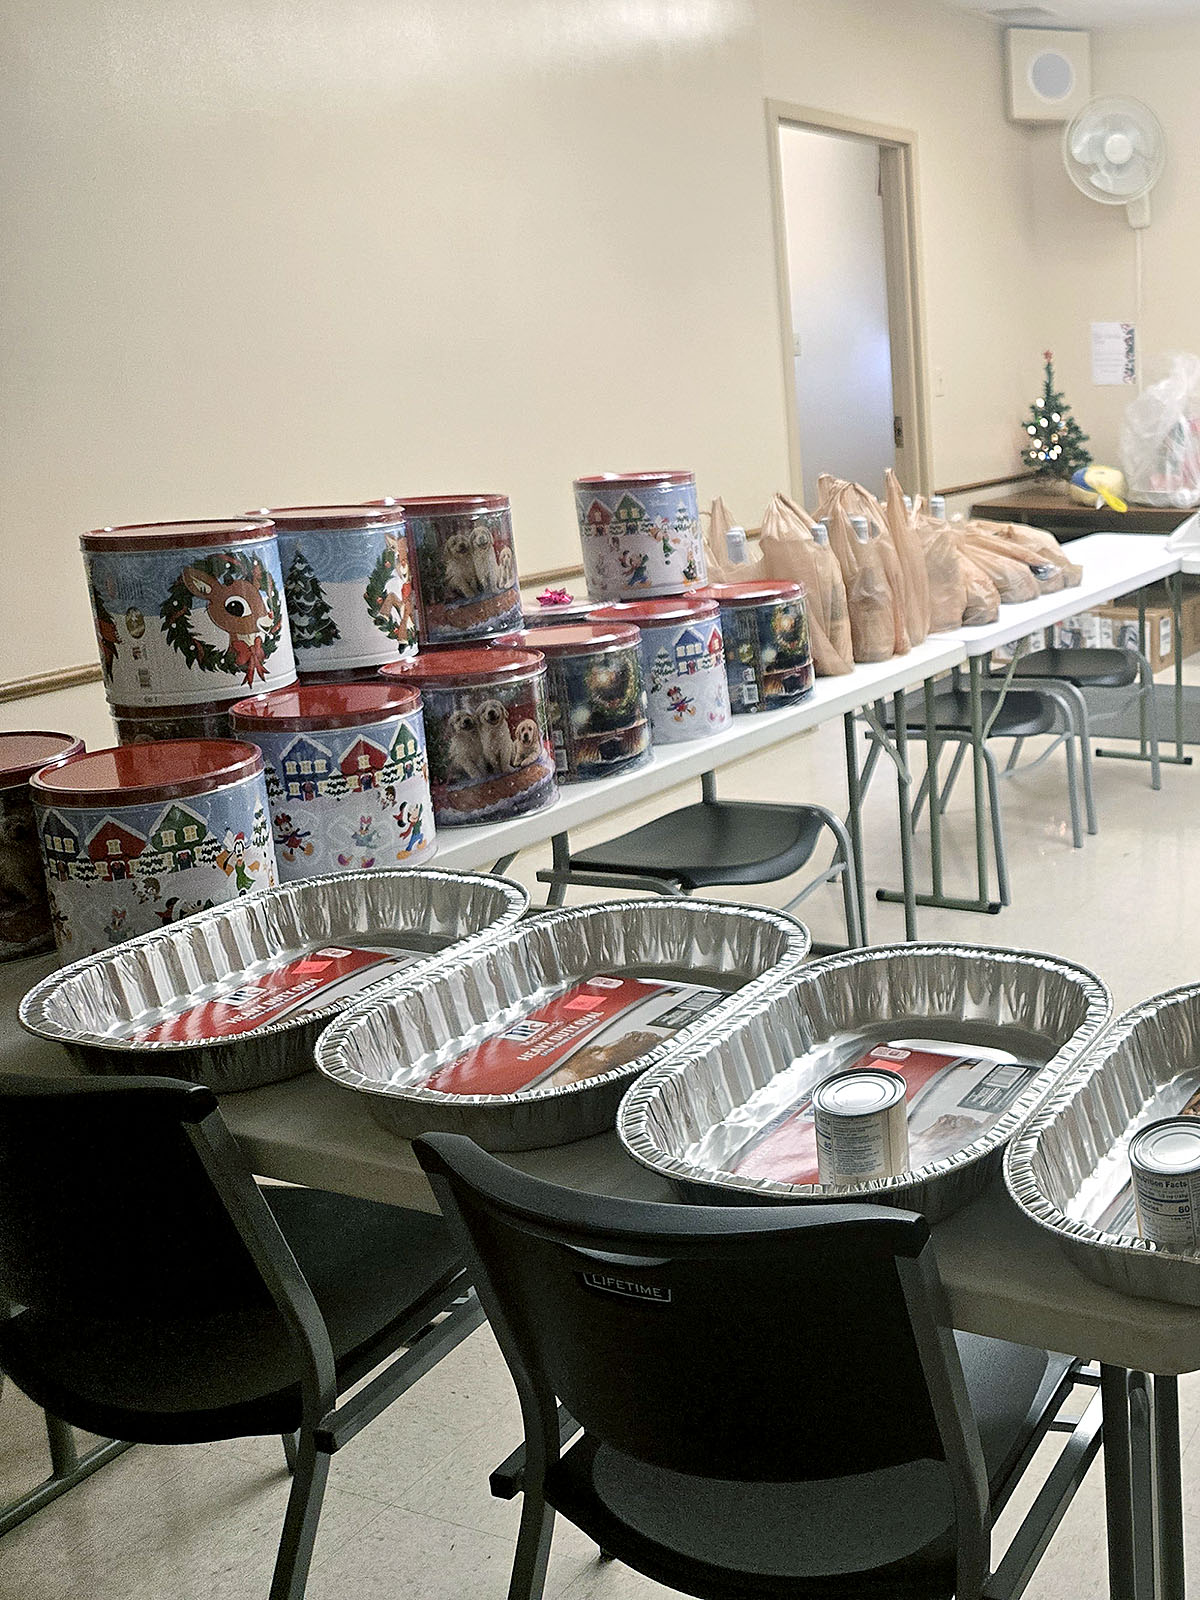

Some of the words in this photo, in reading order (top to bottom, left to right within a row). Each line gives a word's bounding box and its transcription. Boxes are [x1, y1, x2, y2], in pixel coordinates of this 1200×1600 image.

[516, 1039, 555, 1061] HEAVY
[548, 1024, 580, 1041] DUTY
[573, 1011, 605, 1026] OVAL
[1178, 1205, 1190, 1213] 80
[592, 1273, 662, 1297] LIFETIME
